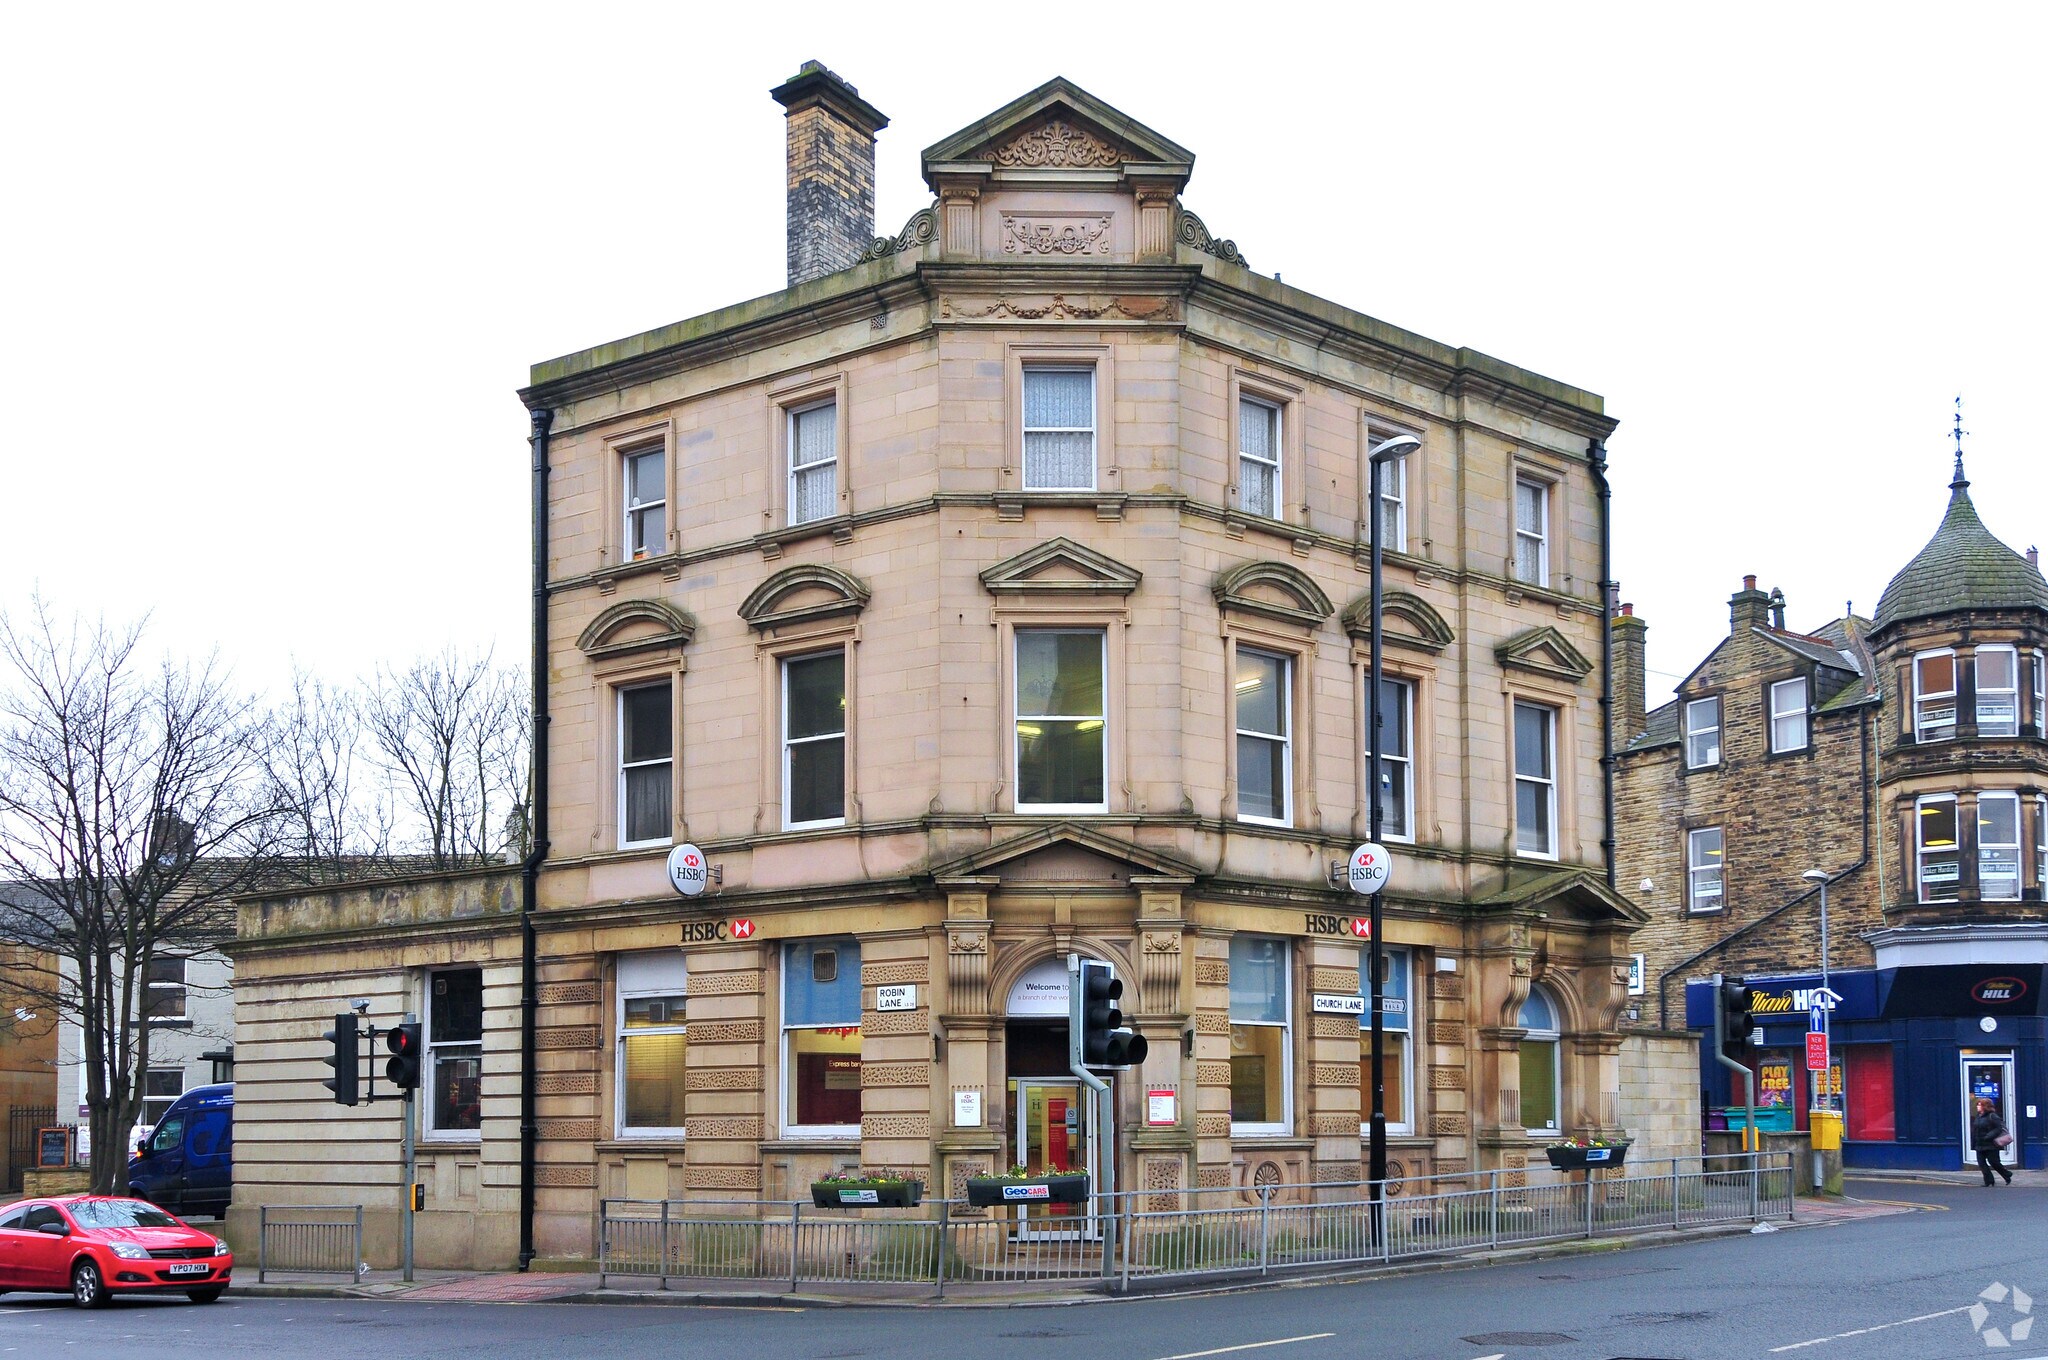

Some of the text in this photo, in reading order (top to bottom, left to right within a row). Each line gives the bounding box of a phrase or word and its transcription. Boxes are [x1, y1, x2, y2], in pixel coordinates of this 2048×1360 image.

[676, 866, 705, 881] HSBC
[1351, 867, 1382, 880] HSBC
[1305, 914, 1349, 935] HSBC
[681, 921, 727, 941] HSBC
[880, 988, 905, 997] ROBIN
[1026, 983, 1061, 991] Welcome
[1982, 989, 2010, 998] HILL
[880, 999, 901, 1007] LANE
[1316, 998, 1362, 1010] CHURCH LANE
[1808, 1051, 1825, 1059] LAYOUT
[829, 1060, 849, 1068] Express
[1762, 1066, 1788, 1078] PLAY
[1761, 1078, 1789, 1090] FREE
